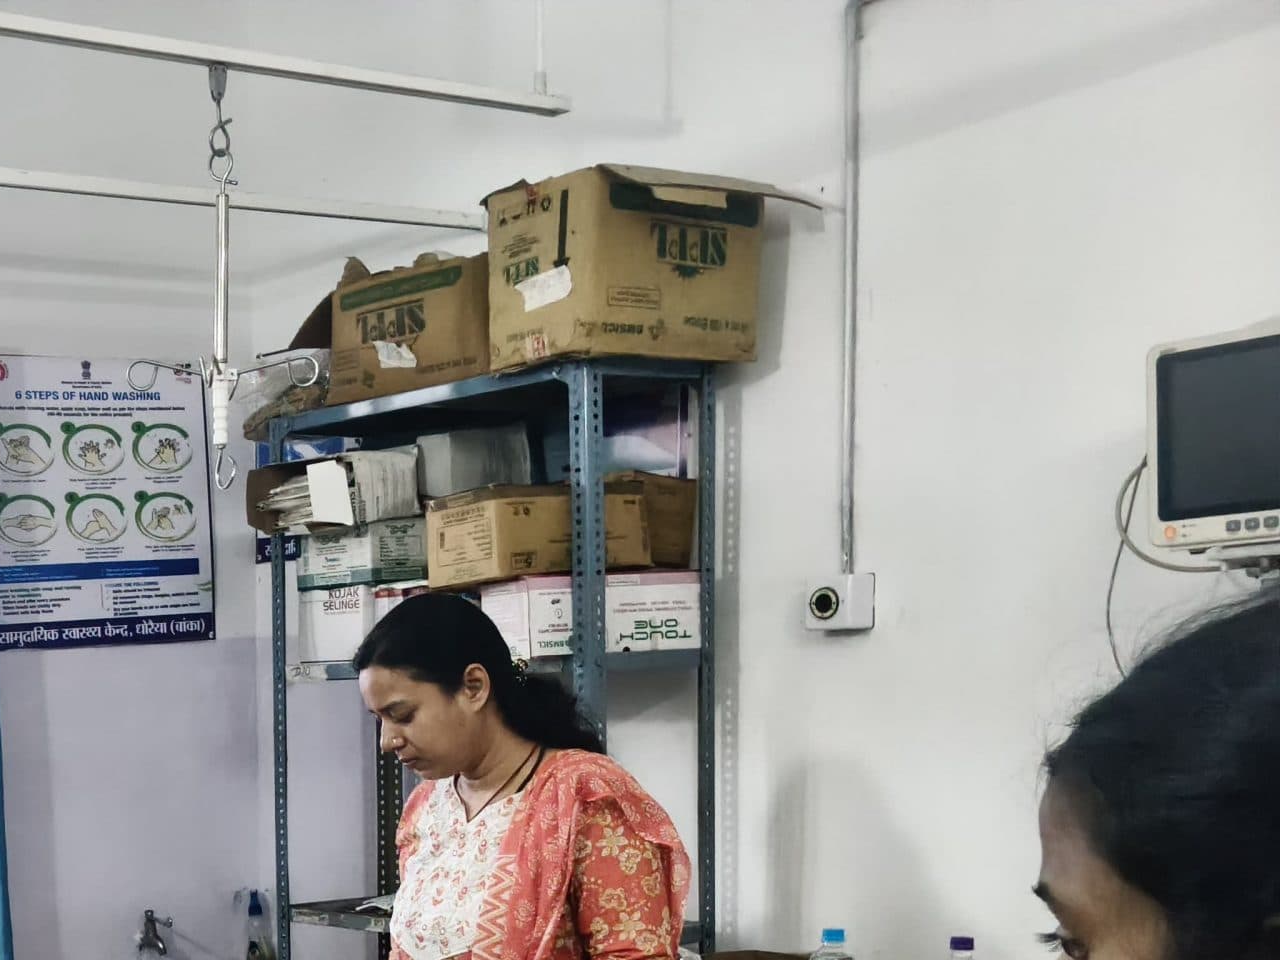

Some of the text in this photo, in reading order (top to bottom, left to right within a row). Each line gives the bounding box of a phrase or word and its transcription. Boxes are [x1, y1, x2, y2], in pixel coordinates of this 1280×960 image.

[14, 390, 161, 401] 6 STEPS OF HAND WASHING
[328, 586, 360, 600] KOJAK
[323, 599, 361, 612] SELINGE
[634, 618, 678, 630] ONE
[620, 629, 693, 641] TOUCH
